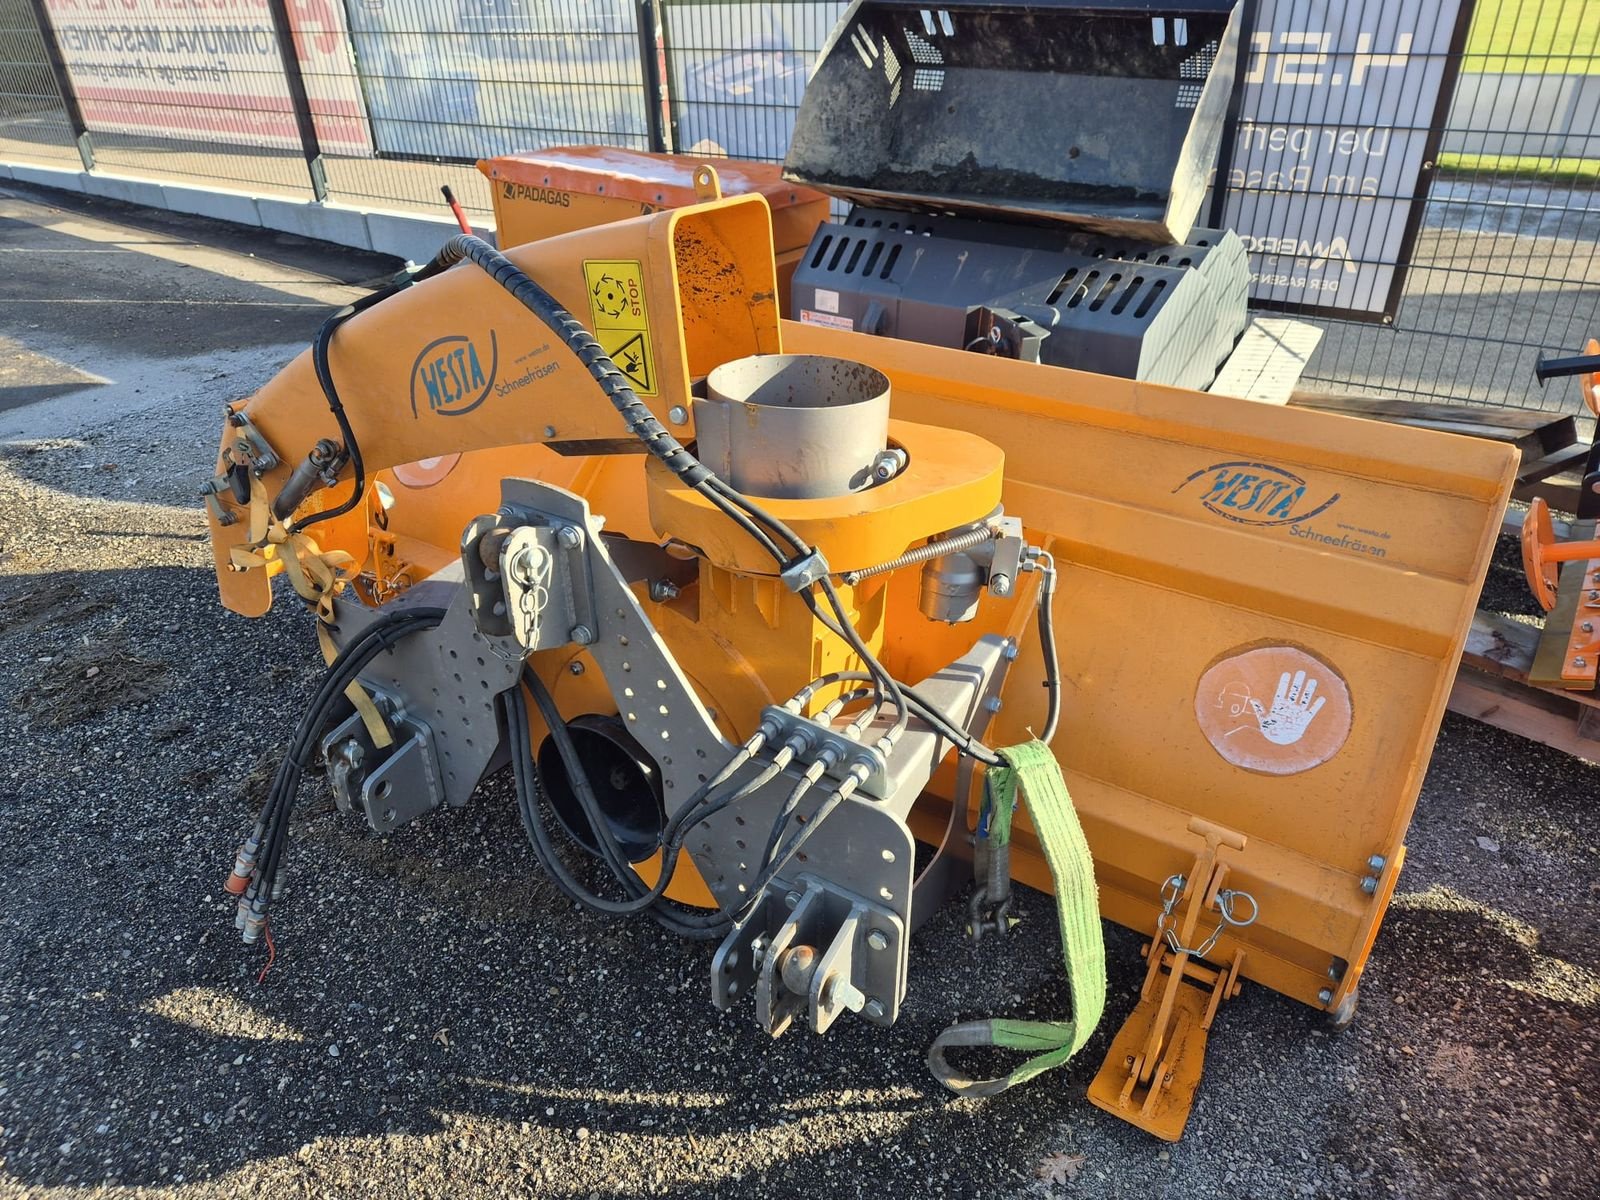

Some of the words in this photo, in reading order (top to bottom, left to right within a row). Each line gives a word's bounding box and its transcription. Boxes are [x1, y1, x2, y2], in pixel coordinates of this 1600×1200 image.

[517, 185, 570, 207] PADAGAS
[628, 279, 641, 316] STOP
[420, 343, 486, 410] WESTA
[494, 360, 560, 398] Schneefräsen
[1200, 469, 1307, 519] WESTA
[1289, 524, 1387, 558] Schneefräsen
